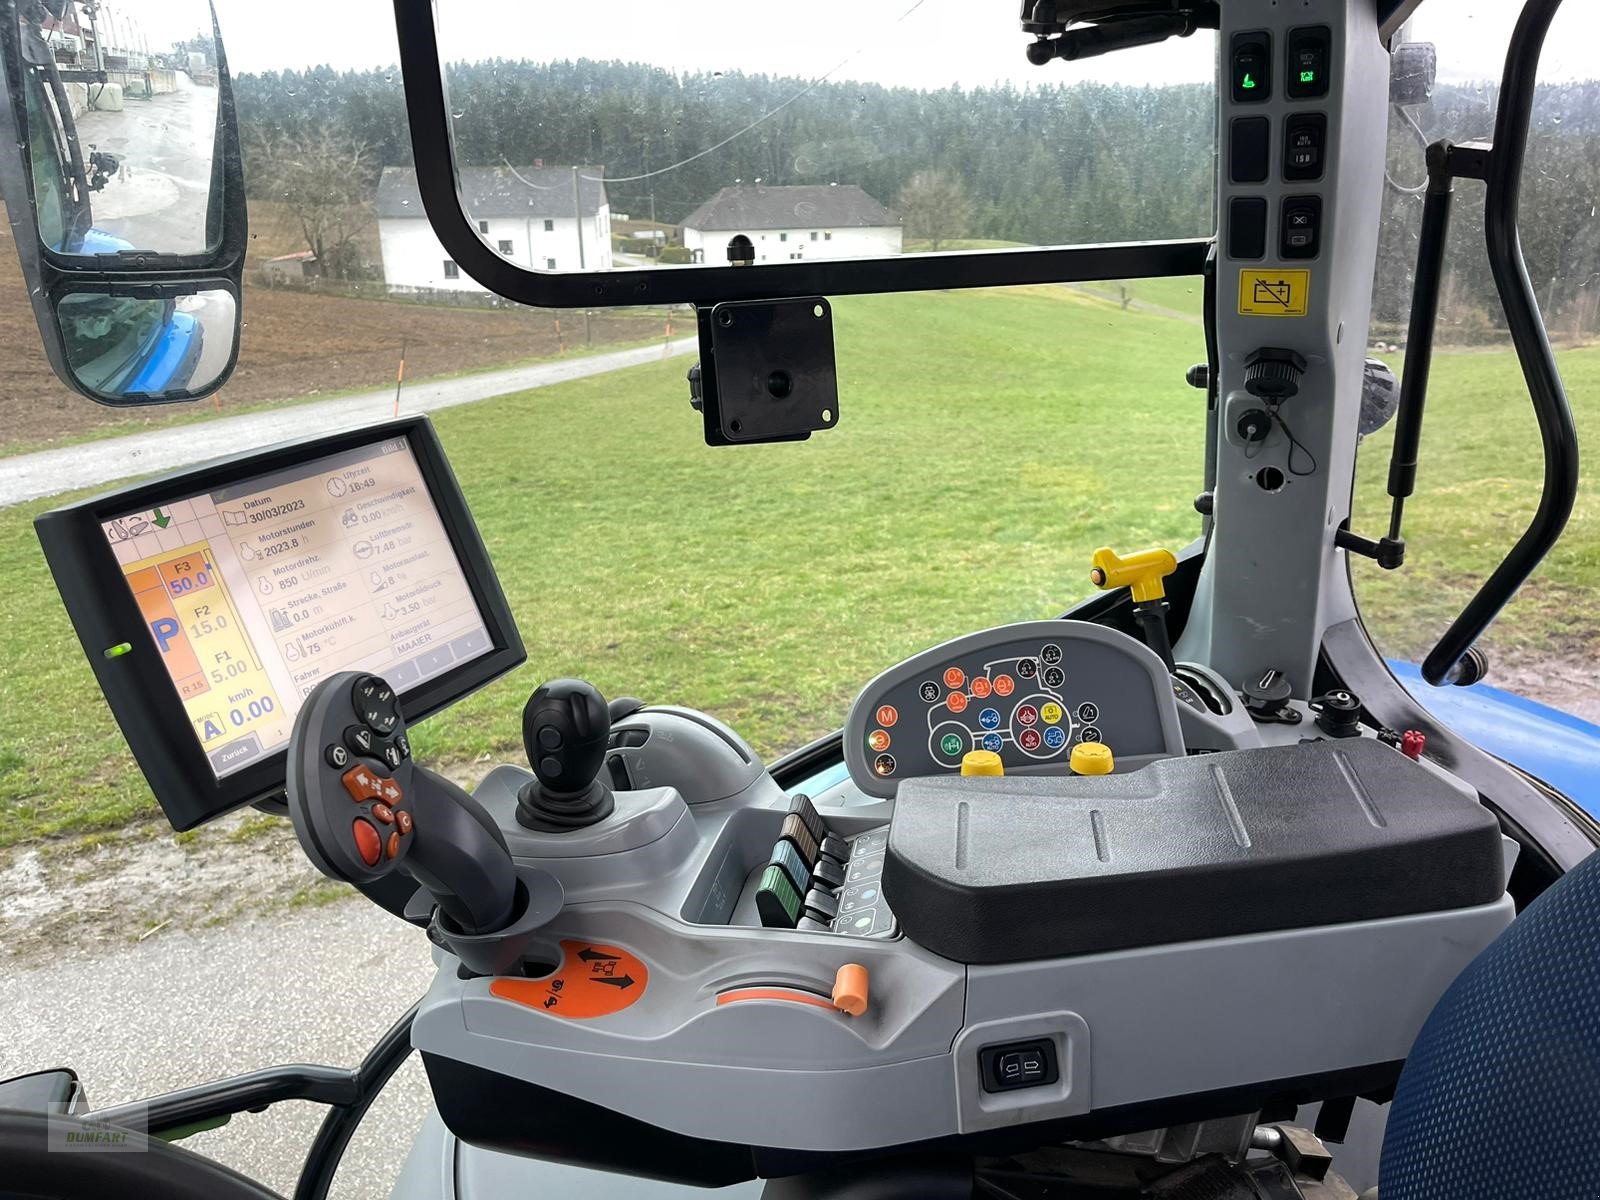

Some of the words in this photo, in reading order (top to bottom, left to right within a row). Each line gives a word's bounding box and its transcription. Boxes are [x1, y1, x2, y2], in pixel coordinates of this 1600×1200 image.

[343, 467, 371, 480] Uhrzeit
[349, 478, 376, 493] 16:49
[243, 496, 272, 510] Datum
[249, 500, 305, 524] 30/03/2023
[362, 510, 382, 523] 0.00
[258, 519, 316, 542] Motorstunden
[264, 539, 299, 557] 2023.8
[374, 541, 396, 555] 7.48
[174, 561, 192, 574] F3
[170, 572, 208, 594] 50.0
[279, 575, 298, 590] 850
[194, 604, 212, 618] F2
[400, 601, 420, 615] 3.50
[293, 609, 310, 623] 0.0
[190, 615, 228, 639] 15.0
[151, 617, 180, 653] P
[307, 644, 321, 656] 75
[396, 633, 432, 654] MAAIER
[215, 650, 232, 664] F1
[210, 660, 248, 684] 5.00
[293, 667, 321, 684] Fahrer
[182, 686, 191, 694] R
[228, 687, 254, 703] km/h
[229, 695, 274, 728] 0.00
[881, 710, 893, 722] M
[203, 719, 221, 740] A
[221, 745, 249, 763] Zurück
